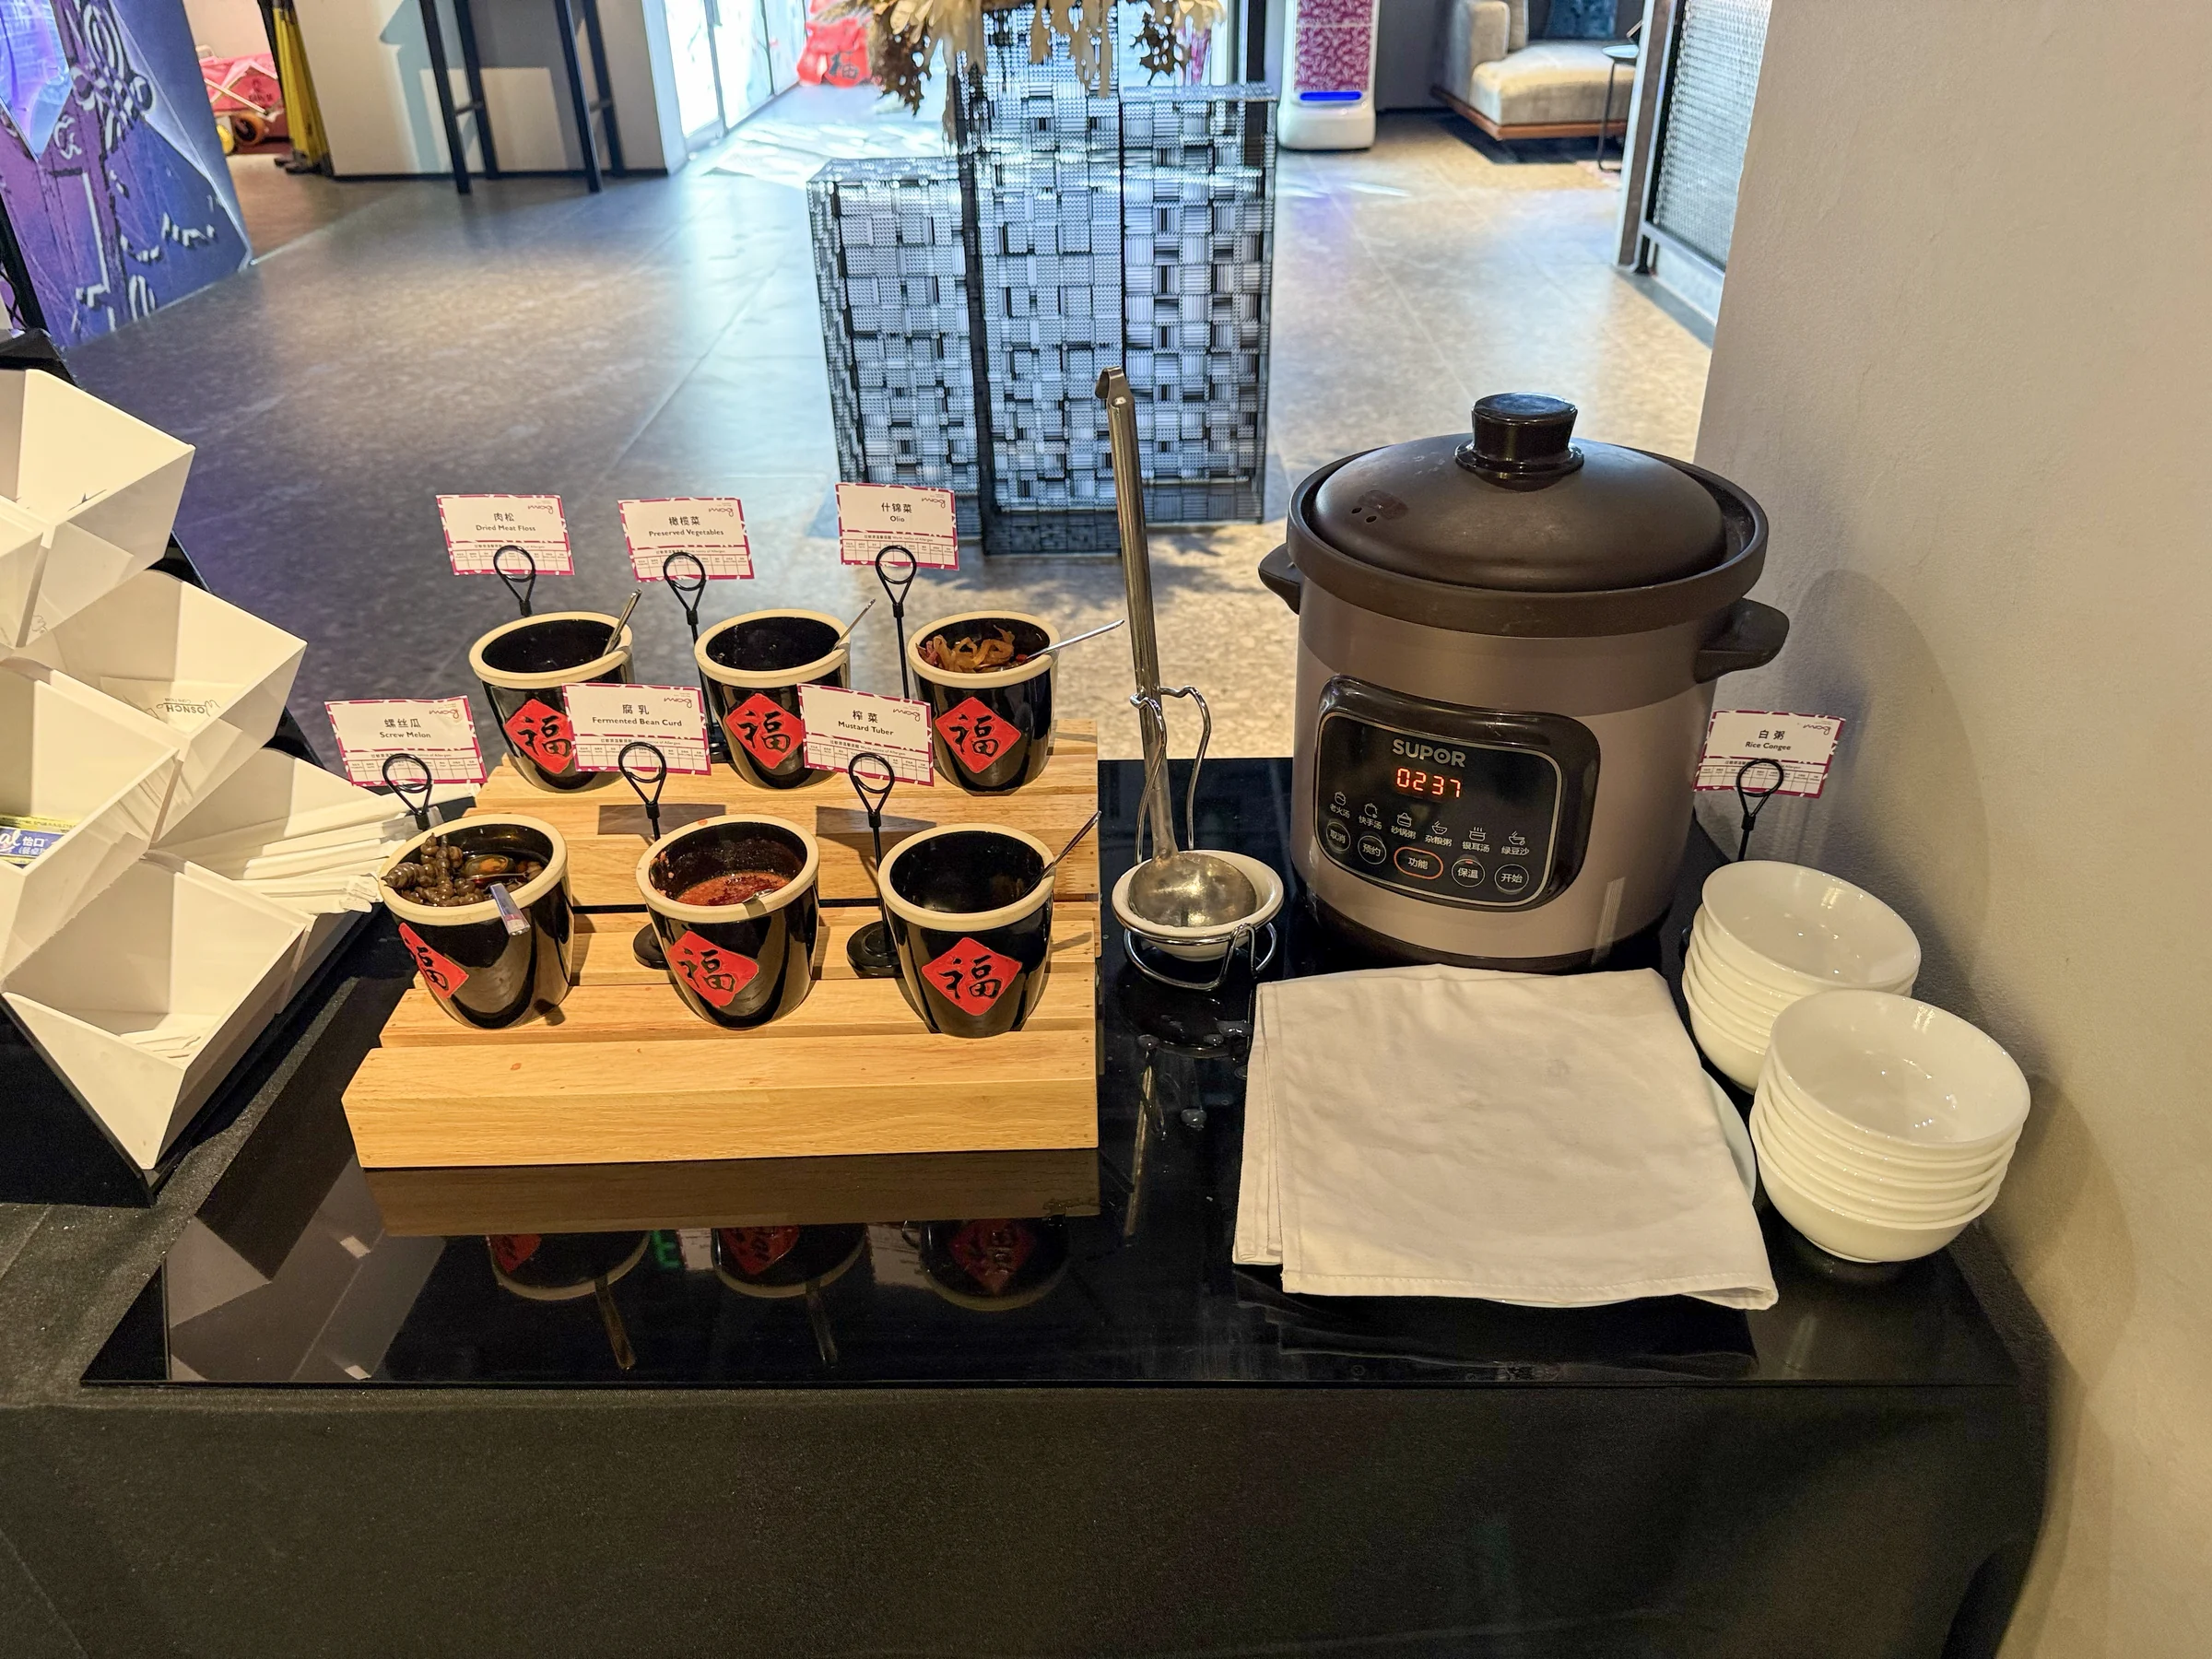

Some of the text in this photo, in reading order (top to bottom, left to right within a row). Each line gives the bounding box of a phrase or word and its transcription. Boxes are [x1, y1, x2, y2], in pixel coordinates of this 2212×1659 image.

[881, 502, 912, 513] 什锦菜
[493, 512, 514, 522] 肉松
[622, 704, 650, 715] 腐乳
[384, 718, 421, 728] 螺丝瓜
[662, 719, 682, 727] Curd
[853, 710, 878, 724] 榨菜
[737, 710, 792, 754] 福
[838, 720, 894, 735] Mustard Tuber
[517, 715, 572, 758] 福
[949, 715, 998, 757] 福
[1759, 730, 1785, 740] 白粥
[1393, 739, 1466, 768] SUPOR
[1762, 743, 1792, 751] Congee
[1396, 768, 1461, 798] 0237
[1329, 803, 1350, 818] 老火汤
[1359, 815, 1382, 830] 快手汤
[1330, 830, 1346, 844] 取消
[1391, 825, 1417, 840] 砂锅粥
[22, 836, 45, 848] 怡口
[1425, 834, 1453, 847] 杂粮粥
[1462, 841, 1490, 853] 银耳汤
[1363, 842, 1382, 857] 预约
[1500, 846, 1530, 856] 绿豆沙
[1407, 857, 1429, 870] 功能
[1457, 867, 1478, 879] 保温
[1500, 873, 1524, 884] 开始
[678, 947, 737, 993] 福
[940, 955, 1003, 1000] 福
